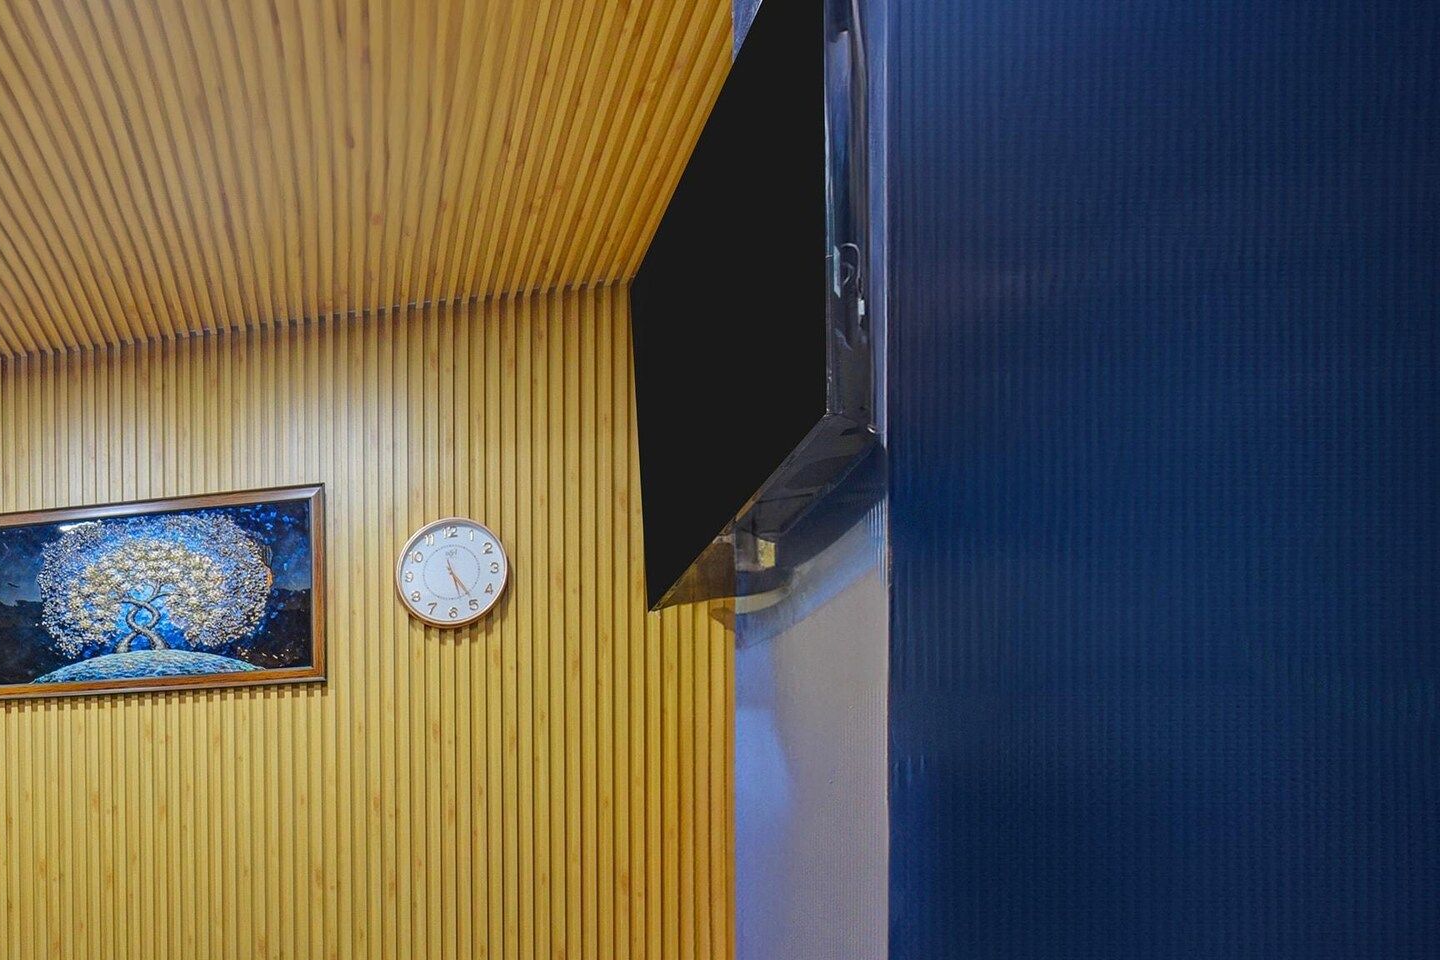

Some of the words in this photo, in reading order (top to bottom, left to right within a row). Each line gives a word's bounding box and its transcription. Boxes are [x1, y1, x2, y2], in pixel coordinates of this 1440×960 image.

[443, 526, 458, 539] 12
[424, 534, 435, 546] 11
[482, 542, 493, 555] 2
[408, 551, 423, 564] 10
[490, 562, 499, 573] 3
[405, 571, 414, 582] 9
[484, 583, 493, 595] 4
[411, 591, 421, 602] 8
[427, 602, 438, 615] 7
[468, 599, 479, 611] 5
[449, 607, 458, 618] 6
